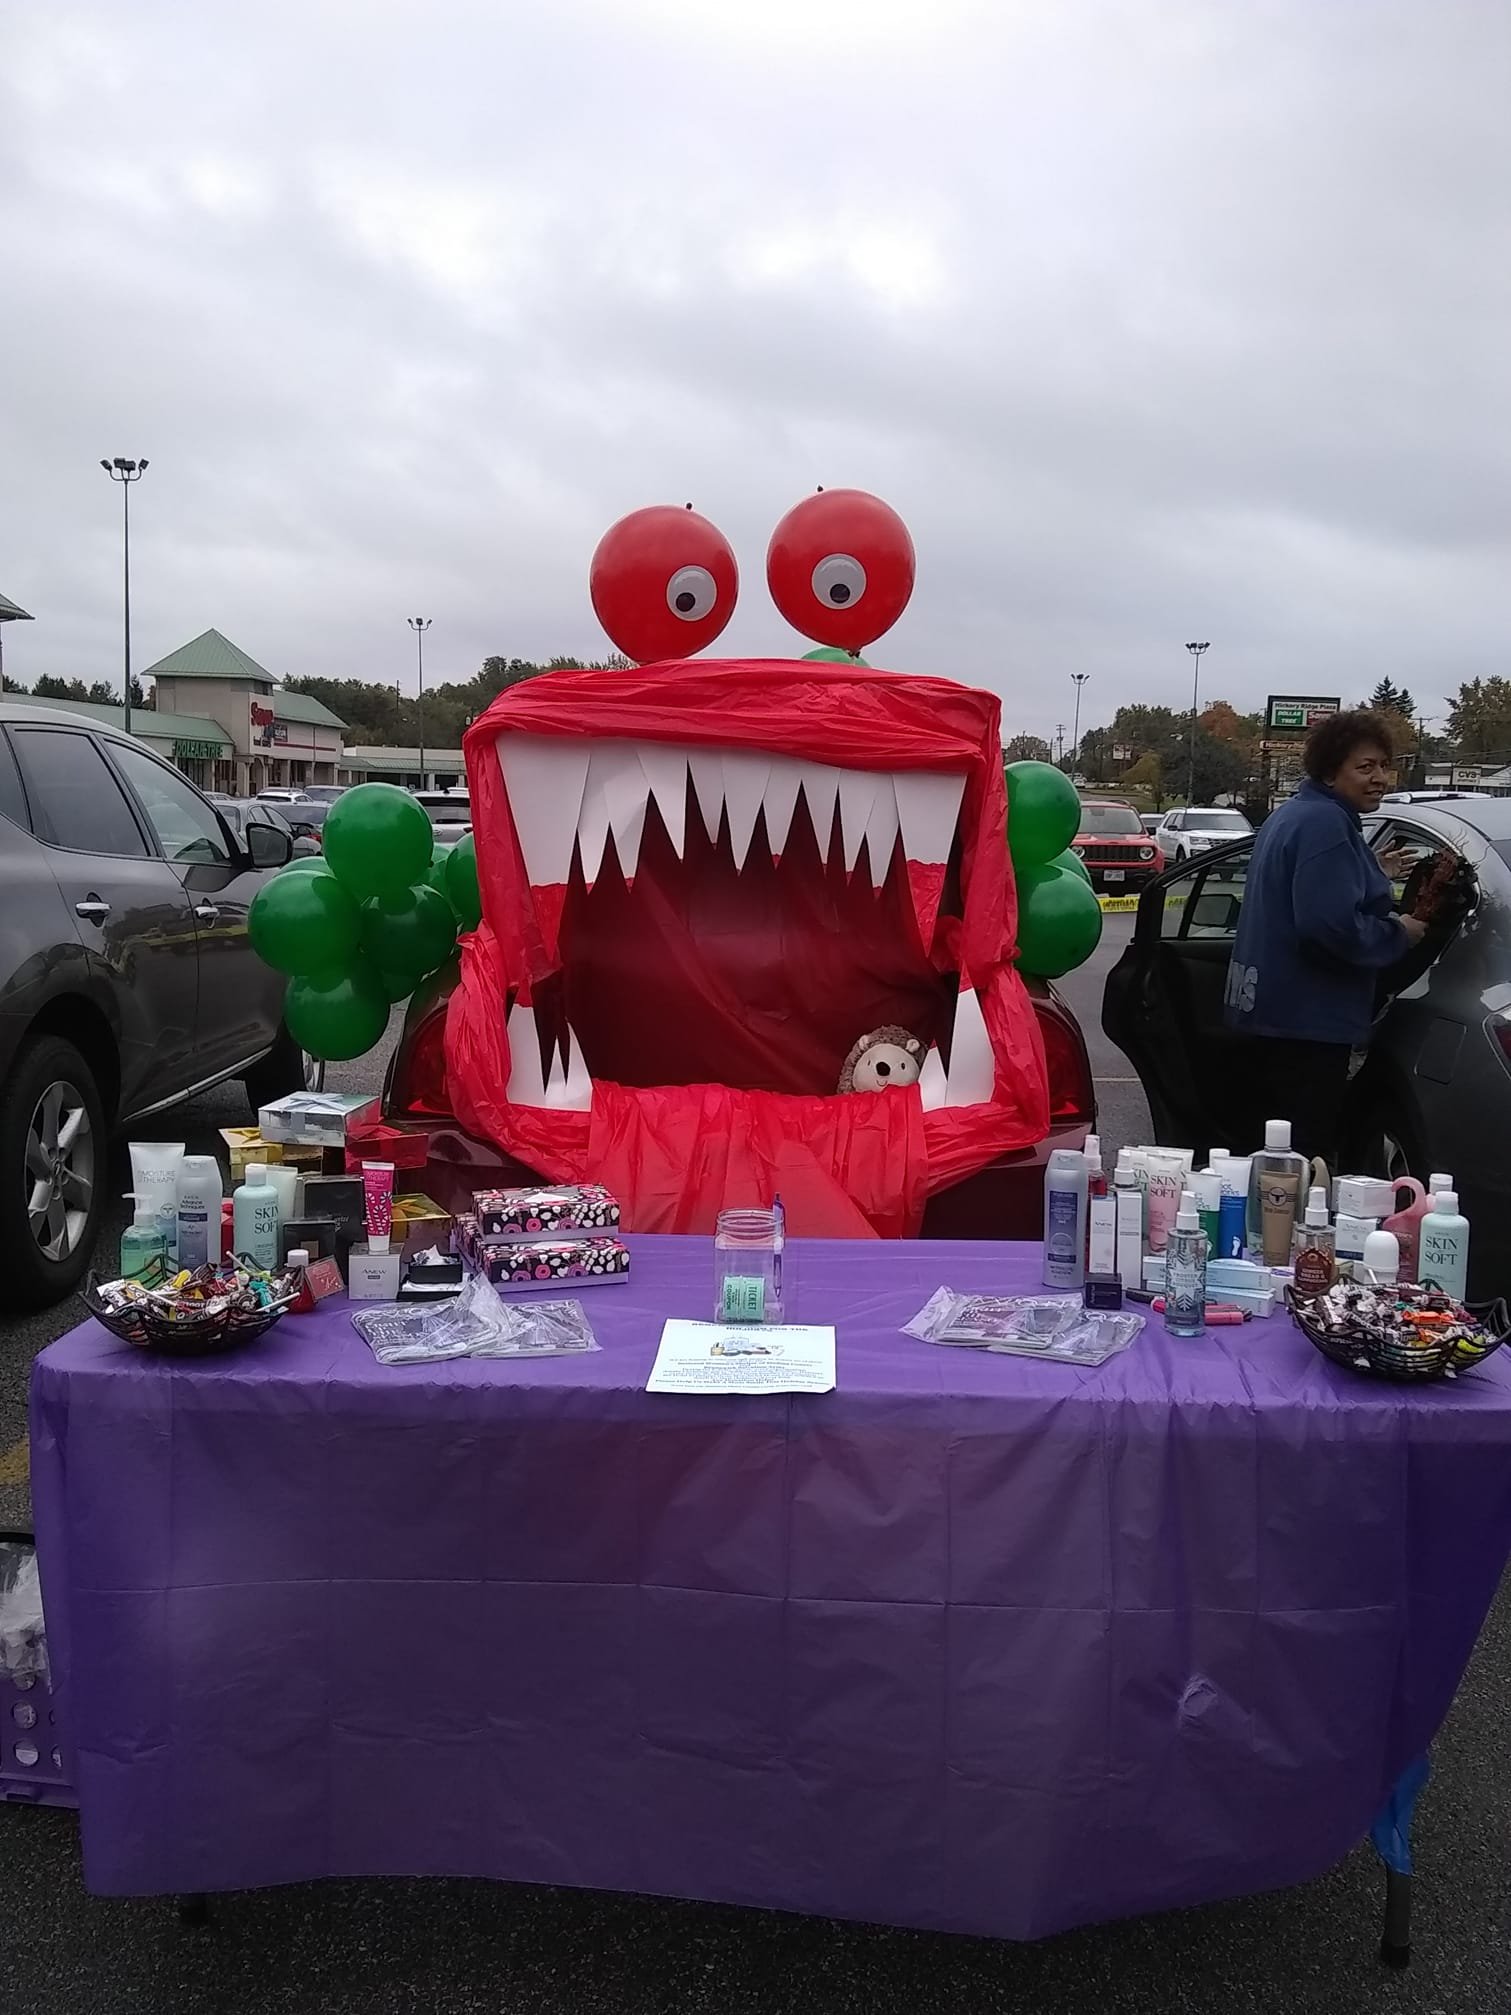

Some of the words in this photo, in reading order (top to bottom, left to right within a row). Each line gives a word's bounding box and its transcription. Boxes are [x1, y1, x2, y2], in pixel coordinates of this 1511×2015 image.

[1301, 703, 1318, 711] Ridge
[1458, 771, 1477, 779] CVS
[142, 1176, 176, 1184] THERAPY
[1150, 1175, 1177, 1186] SKIN
[1150, 1187, 1177, 1198] SOFT
[1425, 1237, 1459, 1250] SKIN
[1424, 1252, 1458, 1265] SOFT
[748, 1286, 757, 1310] TICKET
